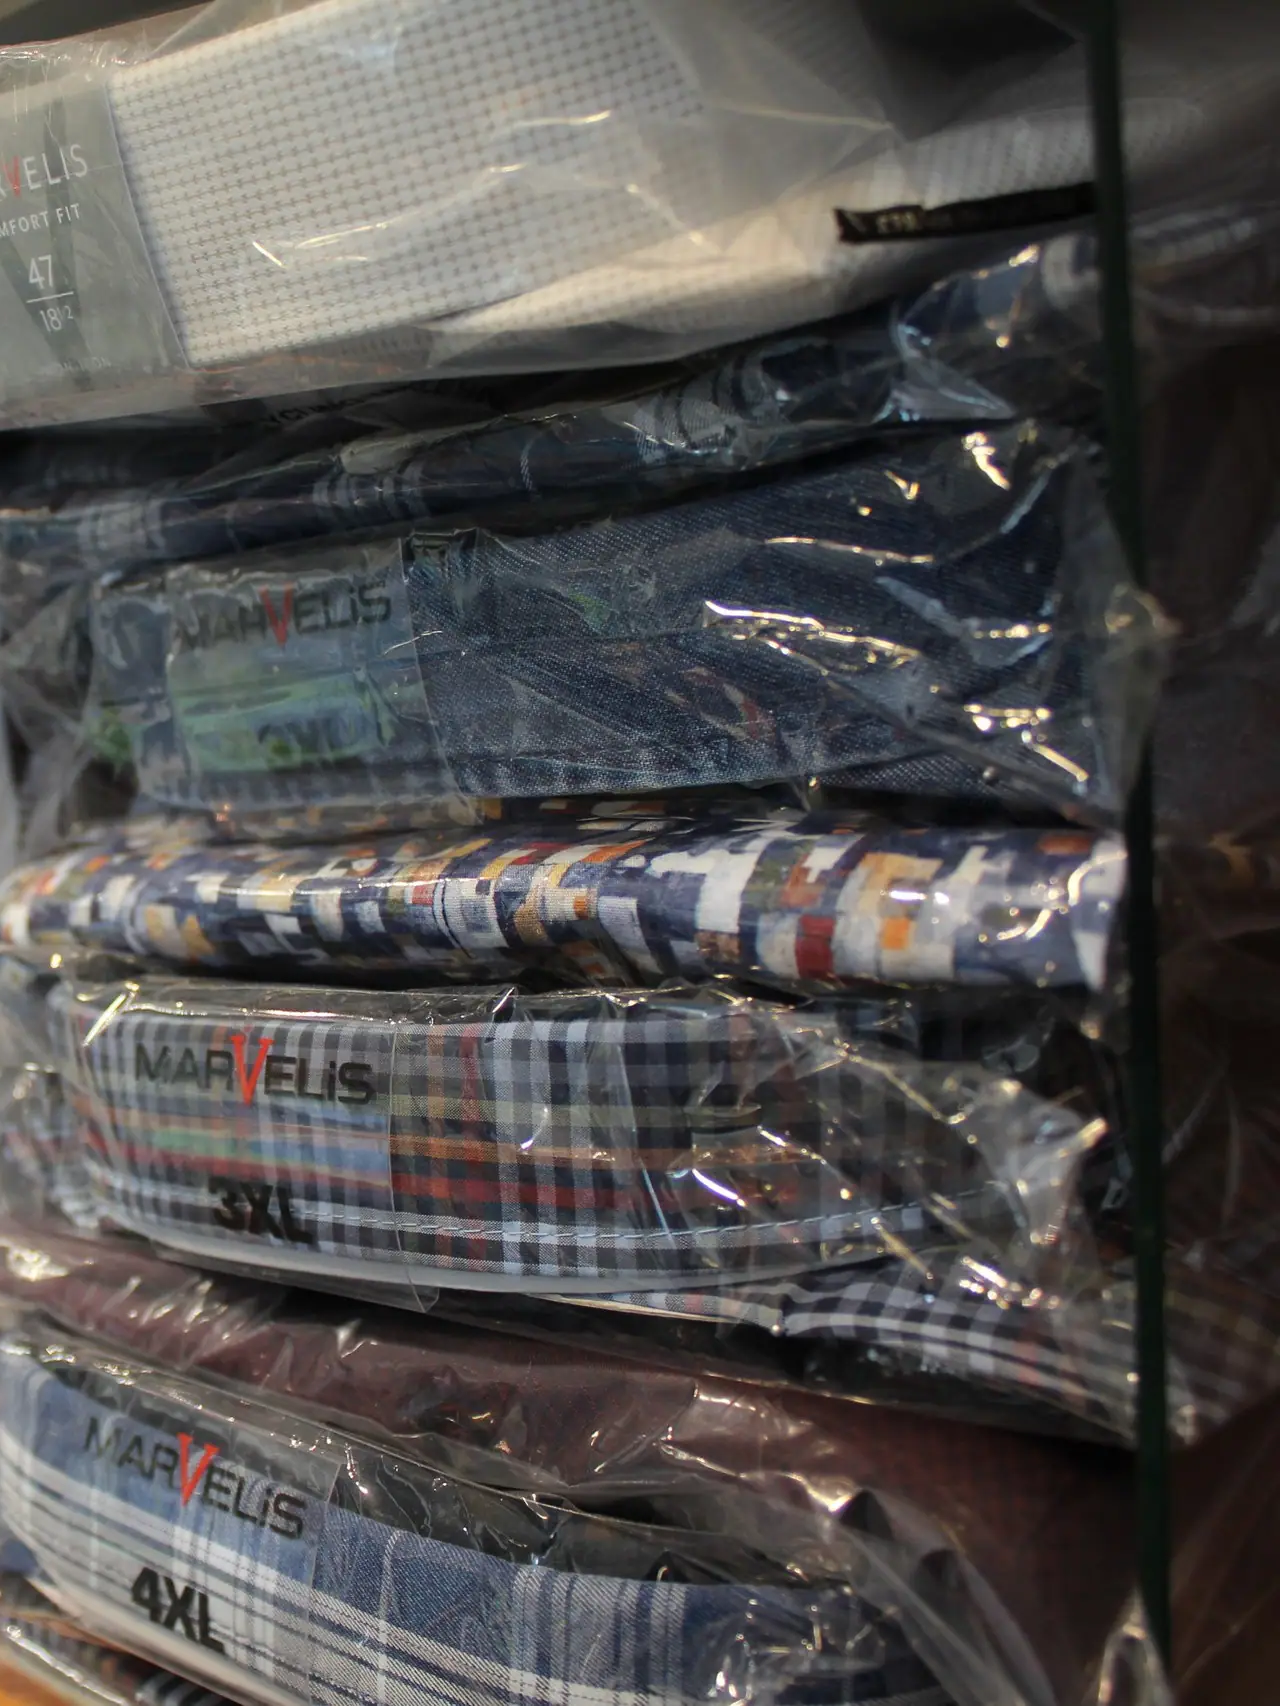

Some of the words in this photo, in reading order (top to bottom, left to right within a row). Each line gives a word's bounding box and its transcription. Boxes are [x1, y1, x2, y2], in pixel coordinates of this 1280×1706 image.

[55, 202, 81, 225] FIT
[28, 253, 54, 290] 47
[207, 1173, 316, 1246] 3XL
[130, 1566, 226, 1655] 4XL
